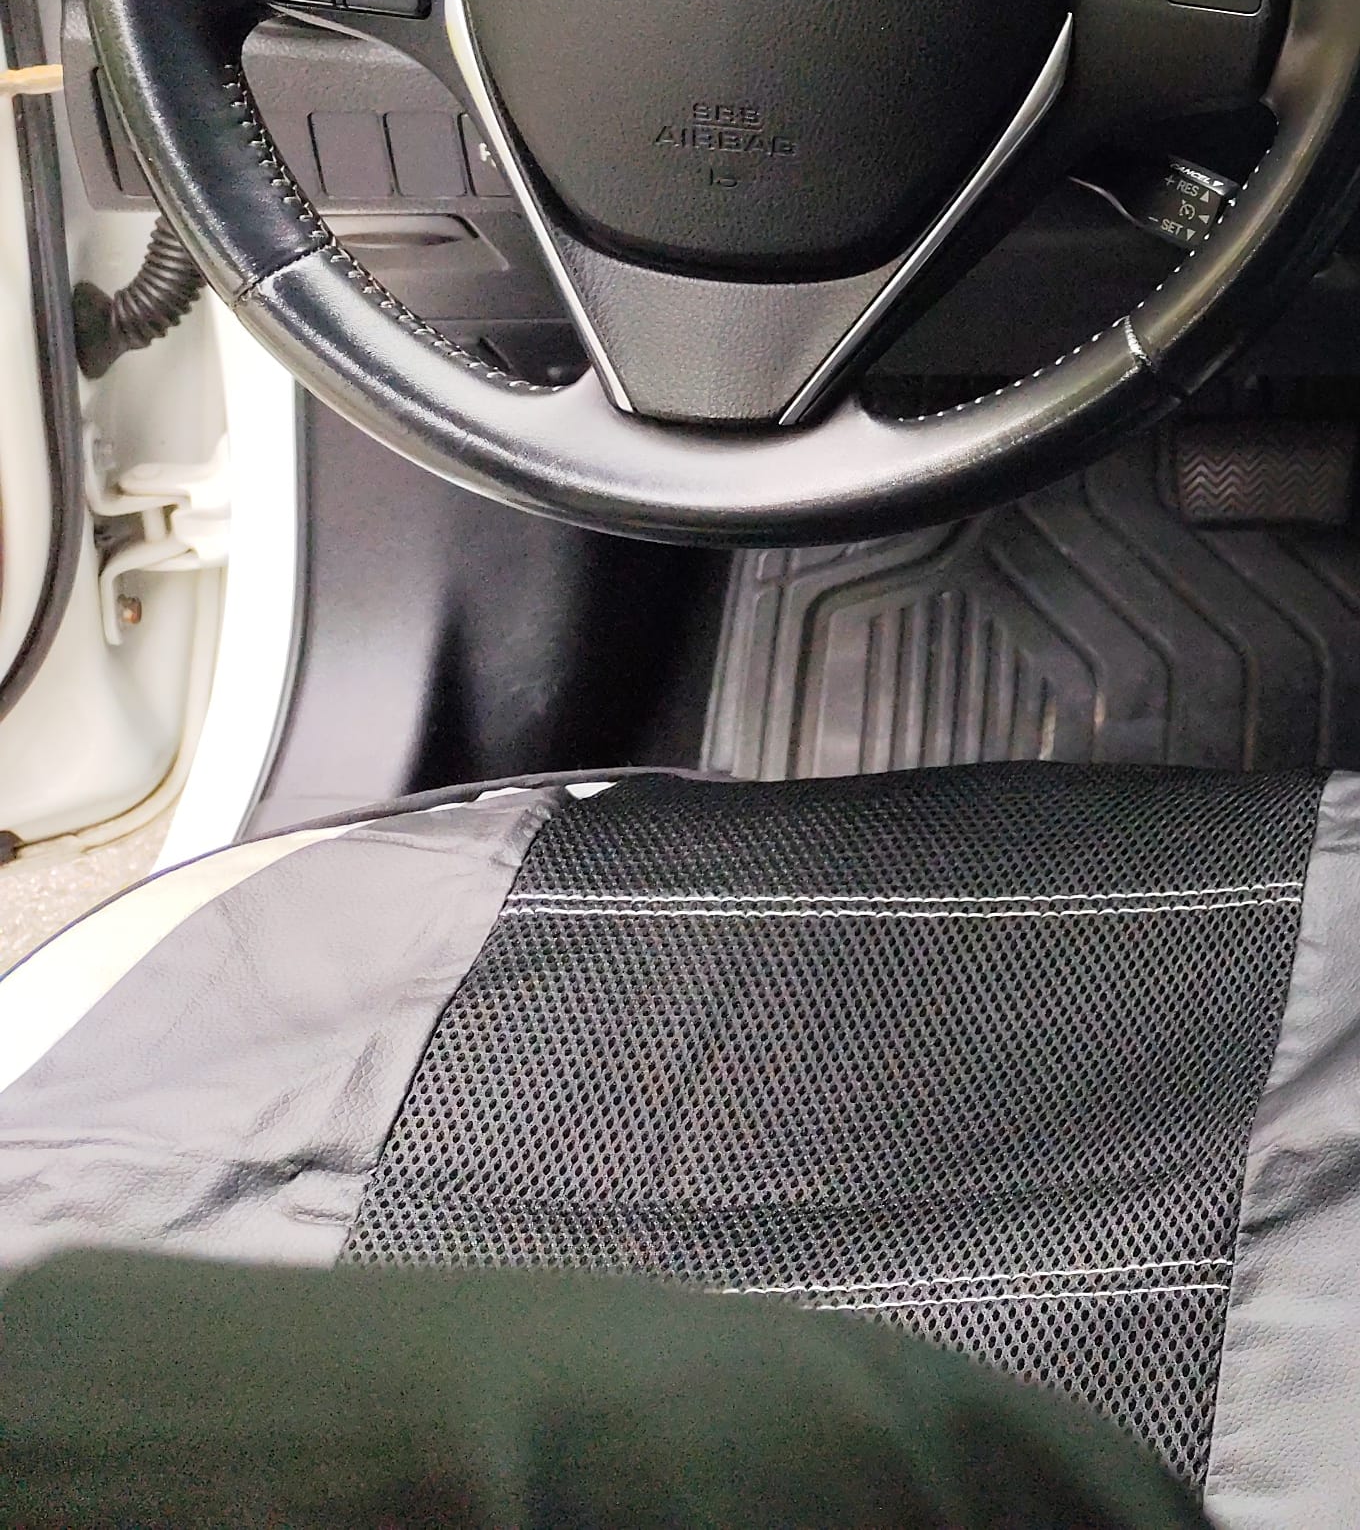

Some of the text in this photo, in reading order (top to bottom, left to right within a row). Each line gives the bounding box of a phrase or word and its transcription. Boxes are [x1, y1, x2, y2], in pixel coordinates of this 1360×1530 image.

[1170, 162, 1211, 185] CANCEL
[1176, 179, 1200, 198] RES
[1160, 218, 1184, 236] SET
